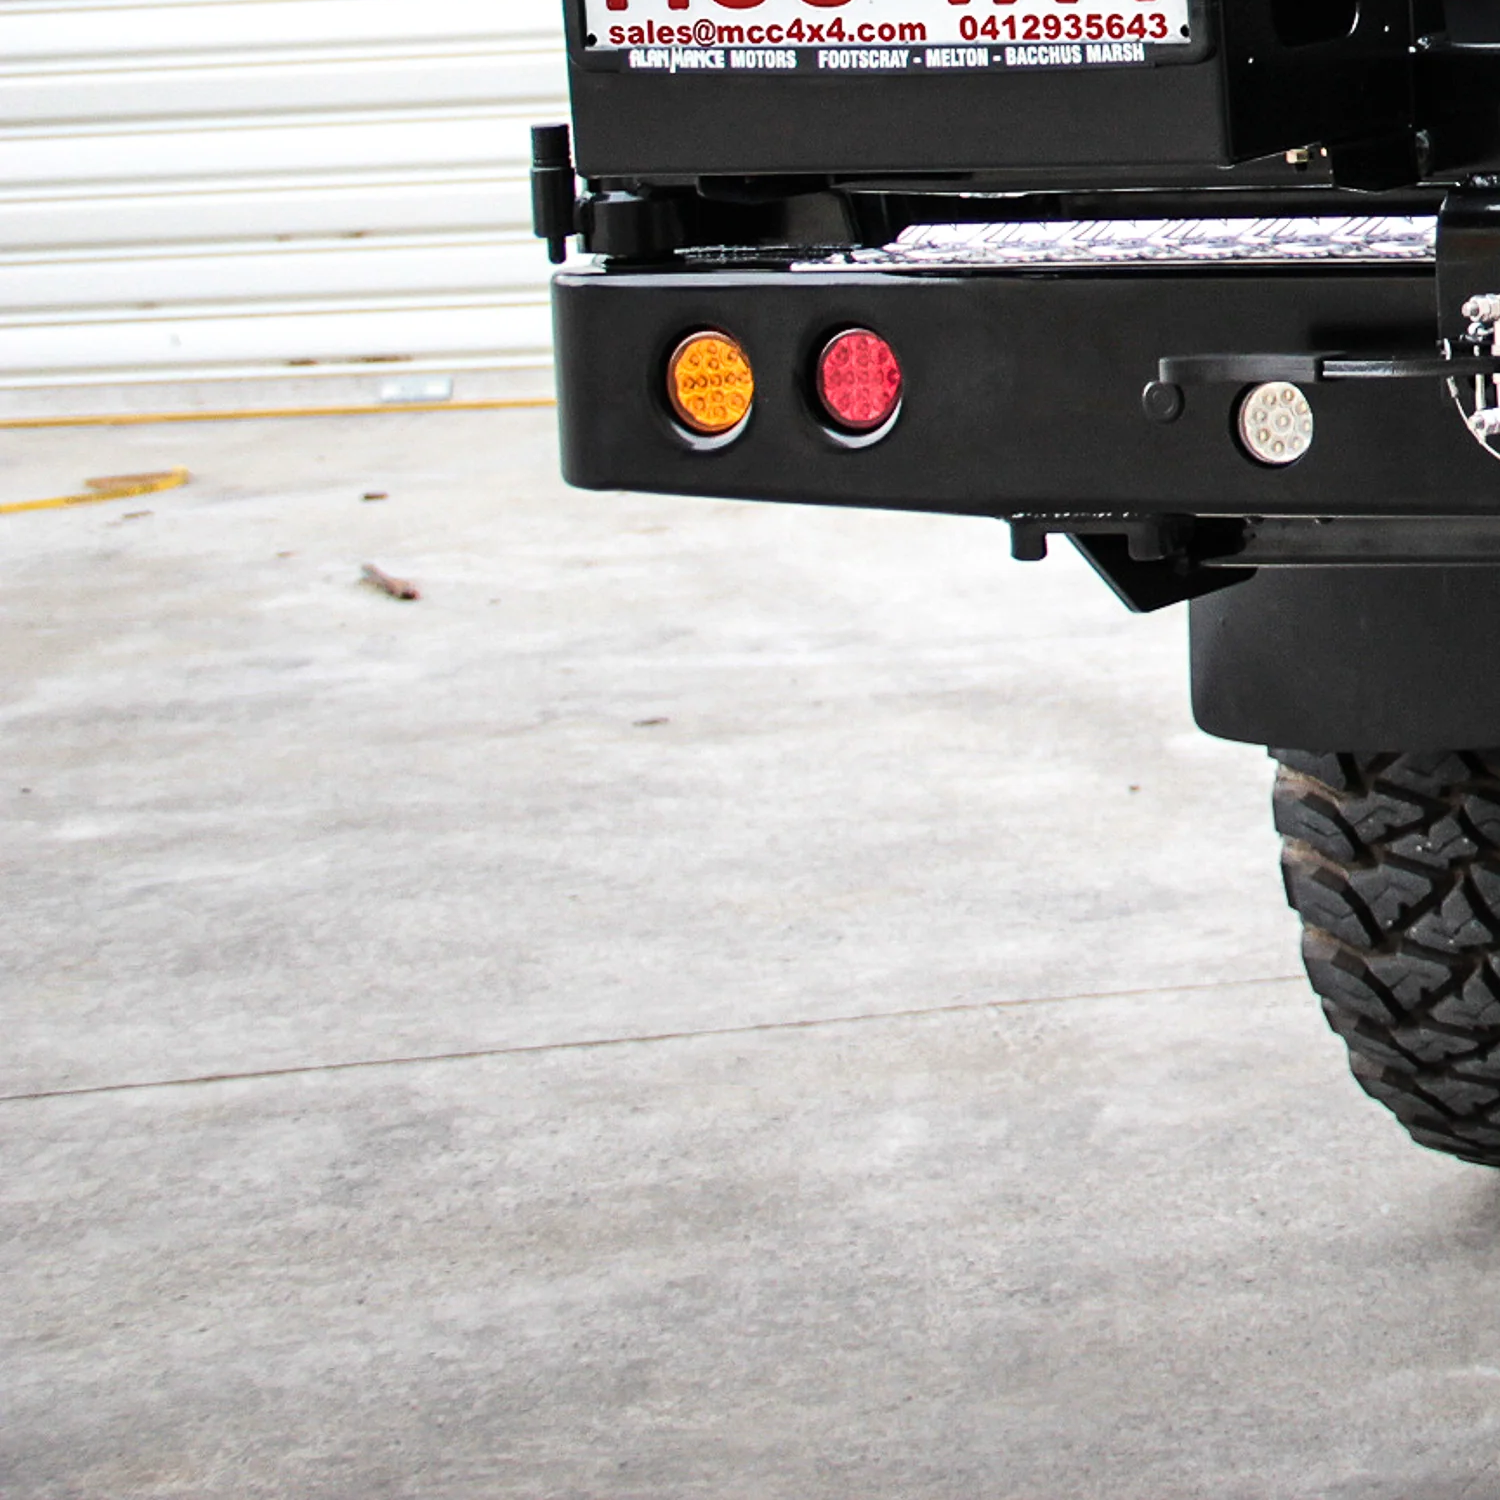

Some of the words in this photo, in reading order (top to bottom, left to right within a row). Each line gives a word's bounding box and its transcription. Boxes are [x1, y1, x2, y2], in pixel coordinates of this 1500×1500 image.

[608, 16, 927, 47] sales@mcc4x4.com
[959, 13, 1169, 41] 0412935643
[730, 49, 797, 69] MOTORS
[818, 48, 910, 69] FOOTSCRAY
[926, 47, 989, 68] MELTON
[1005, 45, 1082, 66] BACCHUS
[1086, 42, 1145, 63] MARSH
